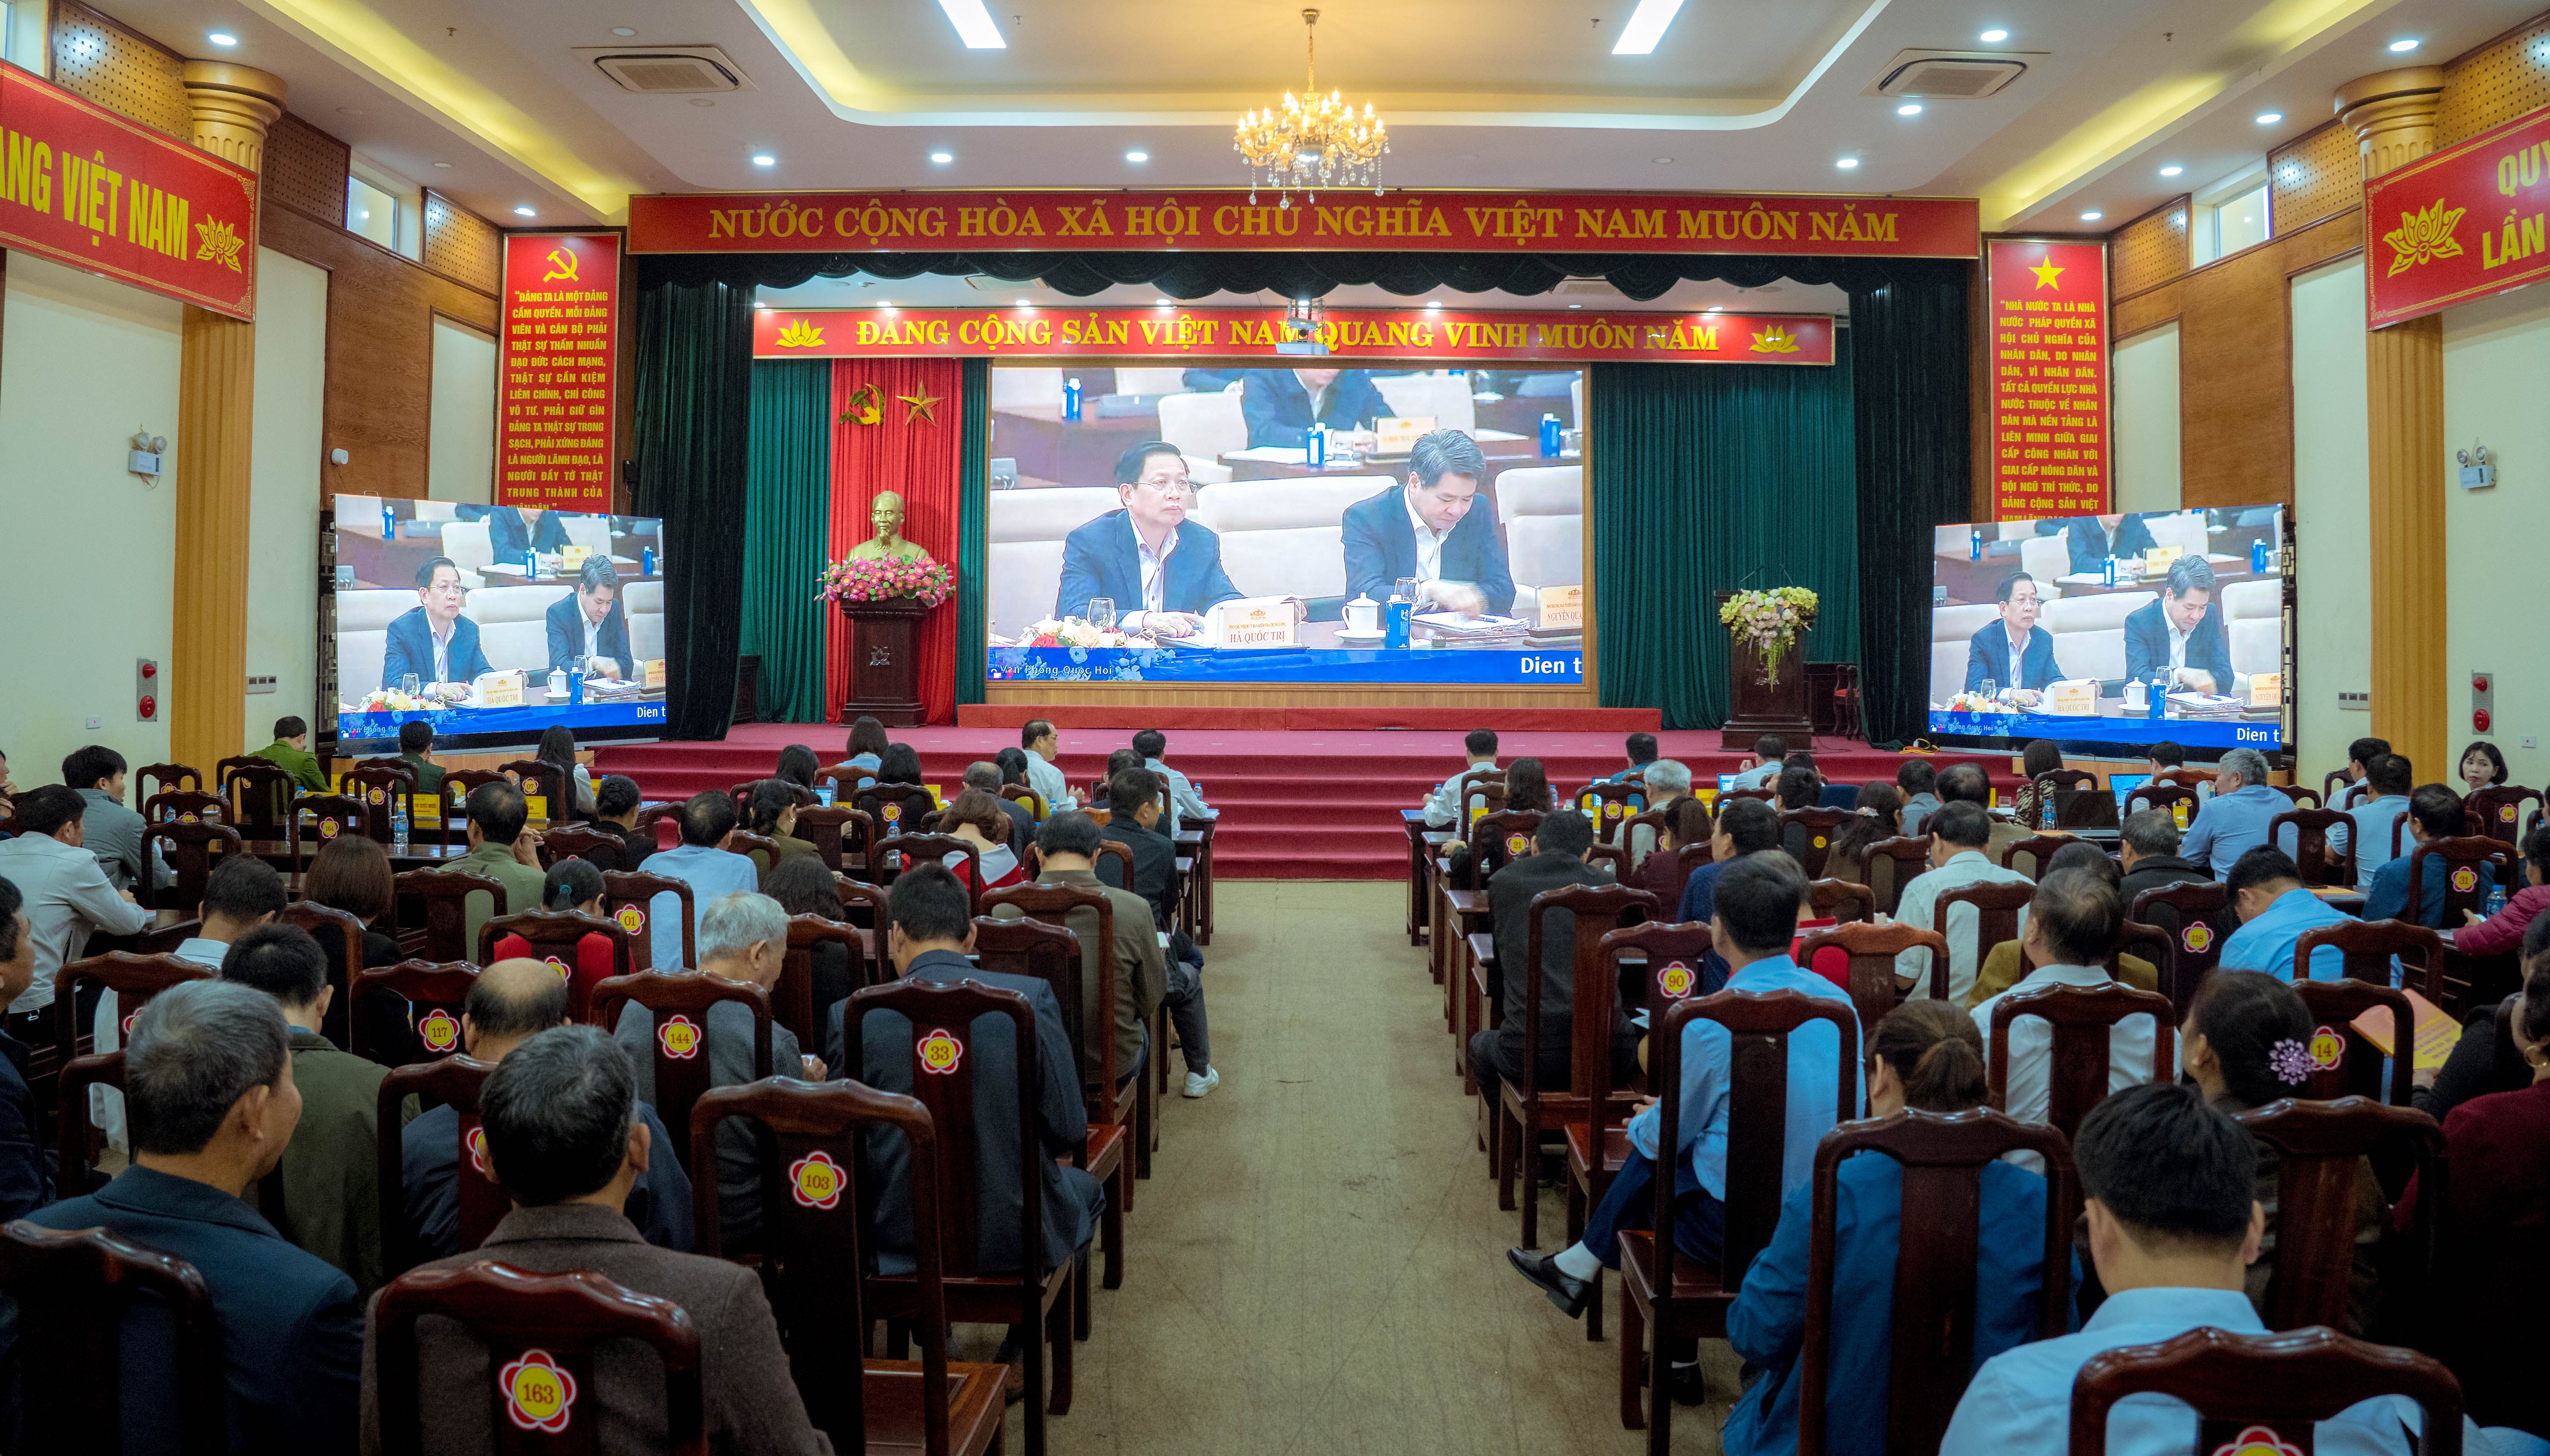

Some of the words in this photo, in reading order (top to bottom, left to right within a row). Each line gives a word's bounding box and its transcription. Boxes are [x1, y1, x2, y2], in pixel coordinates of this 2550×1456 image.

[0, 127, 52, 214] NG
[62, 150, 122, 247] VIỆT
[129, 179, 189, 261] NAM
[708, 199, 823, 237] NƯỚC
[834, 198, 948, 245] CỘNG
[957, 198, 1045, 236] HÒA
[1057, 198, 1114, 235] XÃ
[1125, 198, 1201, 244] HỘI
[1213, 197, 1302, 235] CHỦ
[1315, 198, 1452, 236] NGHĨA
[1463, 199, 1563, 246] VIỆT
[1575, 208, 1667, 238] NAM
[1677, 201, 1799, 240] MUÔN
[1808, 203, 1899, 242] NĂM
[2482, 209, 2545, 270] LẦN
[515, 290, 542, 302] “ĐẢNG
[544, 293, 552, 301] TA
[554, 290, 564, 301] LÀ
[566, 290, 584, 303] MỘT
[585, 289, 608, 301] ĐẢNG
[513, 306, 531, 318] CẦM
[534, 306, 563, 319] QUYỀN.
[566, 305, 582, 317] MỖI
[584, 305, 607, 317] ĐẢNG
[2000, 300, 2023, 310] “NHÀ
[2026, 300, 2048, 311] NƯỚC
[2052, 303, 2062, 311] TA
[2064, 301, 2075, 311] LÀ
[2078, 302, 2096, 312] NHÀ
[512, 323, 531, 334] VIÊN
[535, 323, 546, 334] VÀ
[550, 323, 567, 334] CÁN
[572, 323, 583, 335] BỘ
[587, 322, 606, 333] PHẢI
[2000, 316, 2023, 327] NƯỚC
[2029, 317, 2051, 327] PHÁP
[2054, 317, 2082, 328] QUYỀN
[2084, 318, 2096, 328] XÃ
[856, 311, 950, 345] ĐẢNG
[959, 314, 1052, 351] CỘNG
[1062, 312, 1130, 345] SẢN
[1138, 314, 1218, 350] VIỆT
[1315, 321, 1434, 351] QUANG
[1442, 322, 1528, 348] VINH
[1536, 318, 1635, 349] MUÔN
[1643, 319, 1719, 351] NĂM
[2000, 332, 2015, 345] HỘI
[2021, 332, 2039, 343] CHỦ
[2045, 334, 2073, 344] NGHĨA
[2078, 333, 2096, 345] CỦA
[511, 372, 533, 384] THẬT
[538, 373, 552, 384] SỰ
[557, 370, 575, 382] CẦN
[581, 372, 605, 384] KIỆM
[2001, 365, 2023, 377] DÂN,
[2029, 365, 2037, 376] VÌ
[2044, 366, 2069, 377] NHÂN
[2075, 366, 2097, 377] DÂN.
[510, 388, 530, 399] LIÊM
[533, 388, 561, 399] CHÍNH,
[564, 388, 578, 399] CHÍ
[582, 388, 605, 399] CÔNG
[2001, 380, 2016, 392] TẤT
[2018, 381, 2029, 392] CẢ
[2032, 381, 2059, 393] QUYỀN
[2061, 384, 2077, 395] LỰC
[2079, 383, 2097, 394] NHÀ
[510, 405, 520, 415] VÔ
[526, 406, 538, 415] TƯ.
[544, 404, 564, 415] PHẢI
[570, 404, 585, 415] GIỮ
[589, 405, 604, 415] GÌN
[2001, 398, 2025, 409] NƯỚC
[2028, 399, 2056, 411] THUỘC
[2060, 398, 2070, 410] VỀ
[2074, 399, 2097, 410] NHÂN
[2001, 414, 2019, 425] DÂN
[2023, 415, 2037, 425] MÀ
[2040, 414, 2058, 426] NỀN
[2061, 414, 2083, 427] TẢNG
[2087, 416, 2097, 427] LÀ
[2001, 431, 2021, 441] LIÊN
[2026, 433, 2049, 442] MINH
[2054, 432, 2075, 443] GIỮA
[2080, 434, 2097, 443] GIAI
[508, 454, 518, 464] LÀ
[520, 453, 546, 464] NGƯỜI
[548, 454, 570, 464] LÃNH
[572, 455, 591, 466] ĐẠO,
[593, 454, 603, 464] LÀ
[507, 470, 536, 481] NGƯỜI
[541, 469, 558, 481] ĐẦY
[564, 470, 575, 481] TỚ
[581, 470, 603, 483] THẬT
[2002, 466, 2019, 475] GIAI
[2022, 463, 2039, 475] CẤP
[2041, 465, 2065, 475] NÔNG
[2067, 465, 2085, 476] DÂN
[2087, 465, 2098, 476] VÀ
[507, 488, 539, 497] TRUNG
[545, 486, 577, 497] THÀNH
[583, 486, 603, 497] CỦA
[2002, 480, 2016, 493] ĐỘI
[2020, 481, 2038, 492] NGŨ
[2042, 481, 2055, 492] TRÍ
[2059, 481, 2083, 493] THỨC,
[2087, 483, 2098, 492] DO
[2002, 496, 2026, 508] ĐẢNG
[2030, 497, 2054, 510] CỘNG
[2058, 496, 2076, 509] SẢN
[2081, 498, 2098, 511] VIỆT
[1230, 631, 1242, 643] HÀ
[1245, 630, 1269, 644] QUỐC
[1270, 631, 1285, 642] TRỊ
[1095, 666, 1112, 675] Hoi
[1521, 656, 1565, 674] Dien
[1572, 658, 1582, 673] t
[638, 706, 658, 718] Dien
[661, 706, 666, 717] t
[2237, 727, 2267, 741] Dien
[2273, 729, 2280, 742] t
[2459, 876, 2468, 885] 31
[624, 916, 636, 926] 01
[1668, 975, 1684, 987] 90
[432, 1027, 448, 1037] 117
[671, 1033, 690, 1044] 144
[931, 1046, 949, 1060] 33
[2316, 1043, 2332, 1058] 14
[806, 1174, 829, 1190] 103
[524, 1383, 554, 1405] 163
